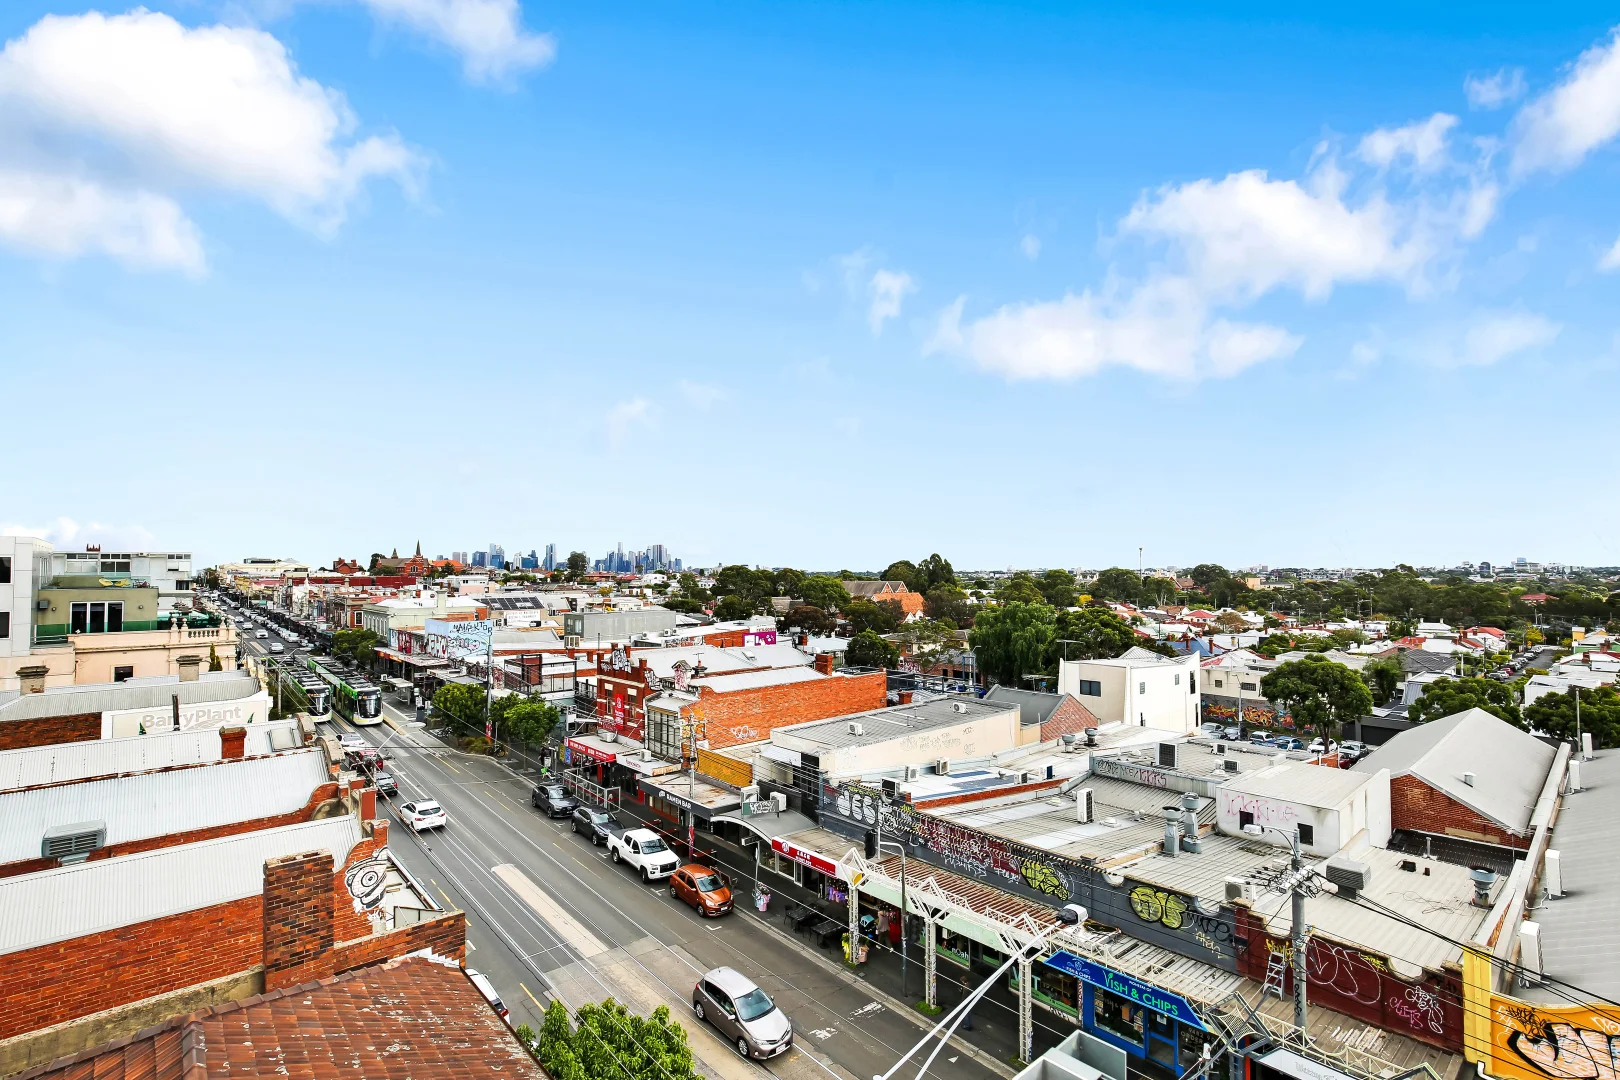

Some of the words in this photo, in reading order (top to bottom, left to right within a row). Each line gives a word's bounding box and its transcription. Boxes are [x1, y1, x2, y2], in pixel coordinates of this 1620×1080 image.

[666, 793, 681, 806] RAMEN
[682, 800, 692, 810] BAR
[1102, 970, 1128, 995] VISH
[1131, 988, 1139, 1000] &
[1142, 993, 1179, 1016] CHIPS
